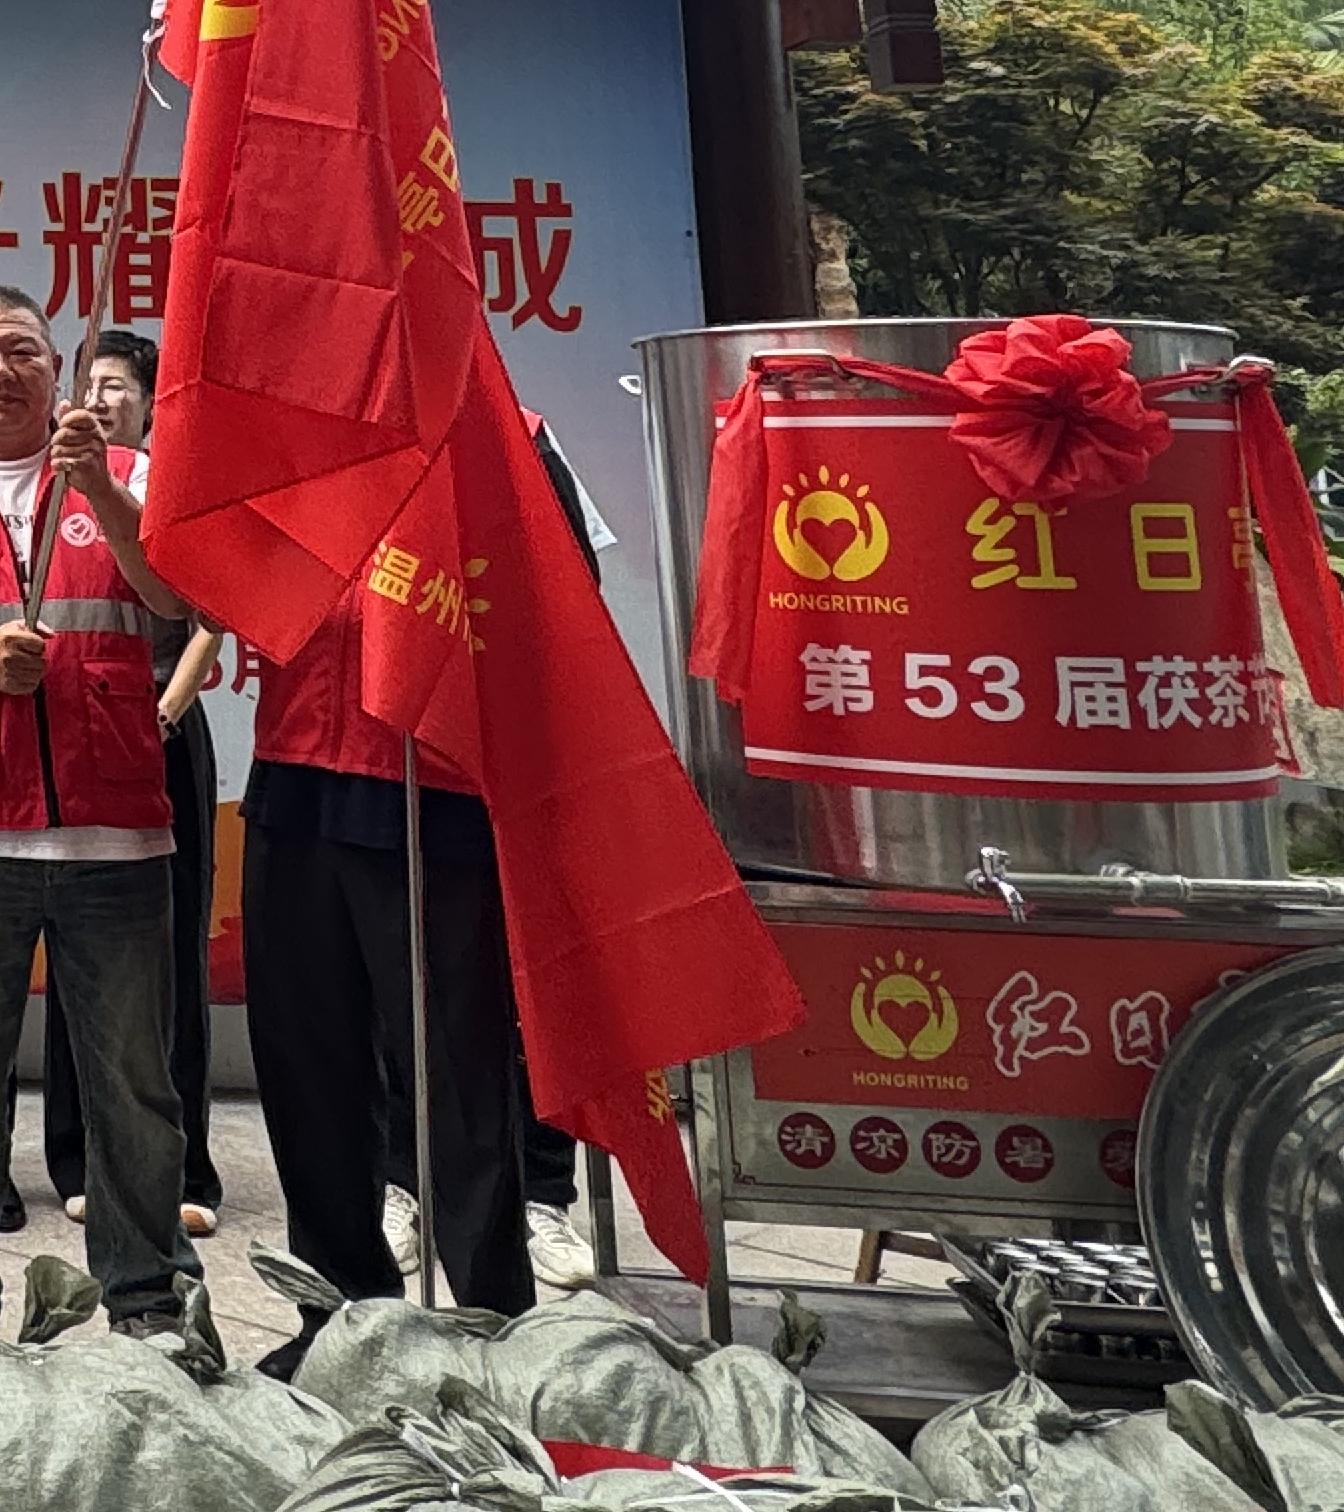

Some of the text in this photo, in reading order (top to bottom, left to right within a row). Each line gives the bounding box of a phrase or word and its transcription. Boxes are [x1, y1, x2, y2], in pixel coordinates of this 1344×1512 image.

[368, 541, 473, 654] 温州
[768, 591, 910, 616] HONGRITING
[986, 970, 1247, 1078] 红日
[852, 1070, 970, 1092] HONGRITING
